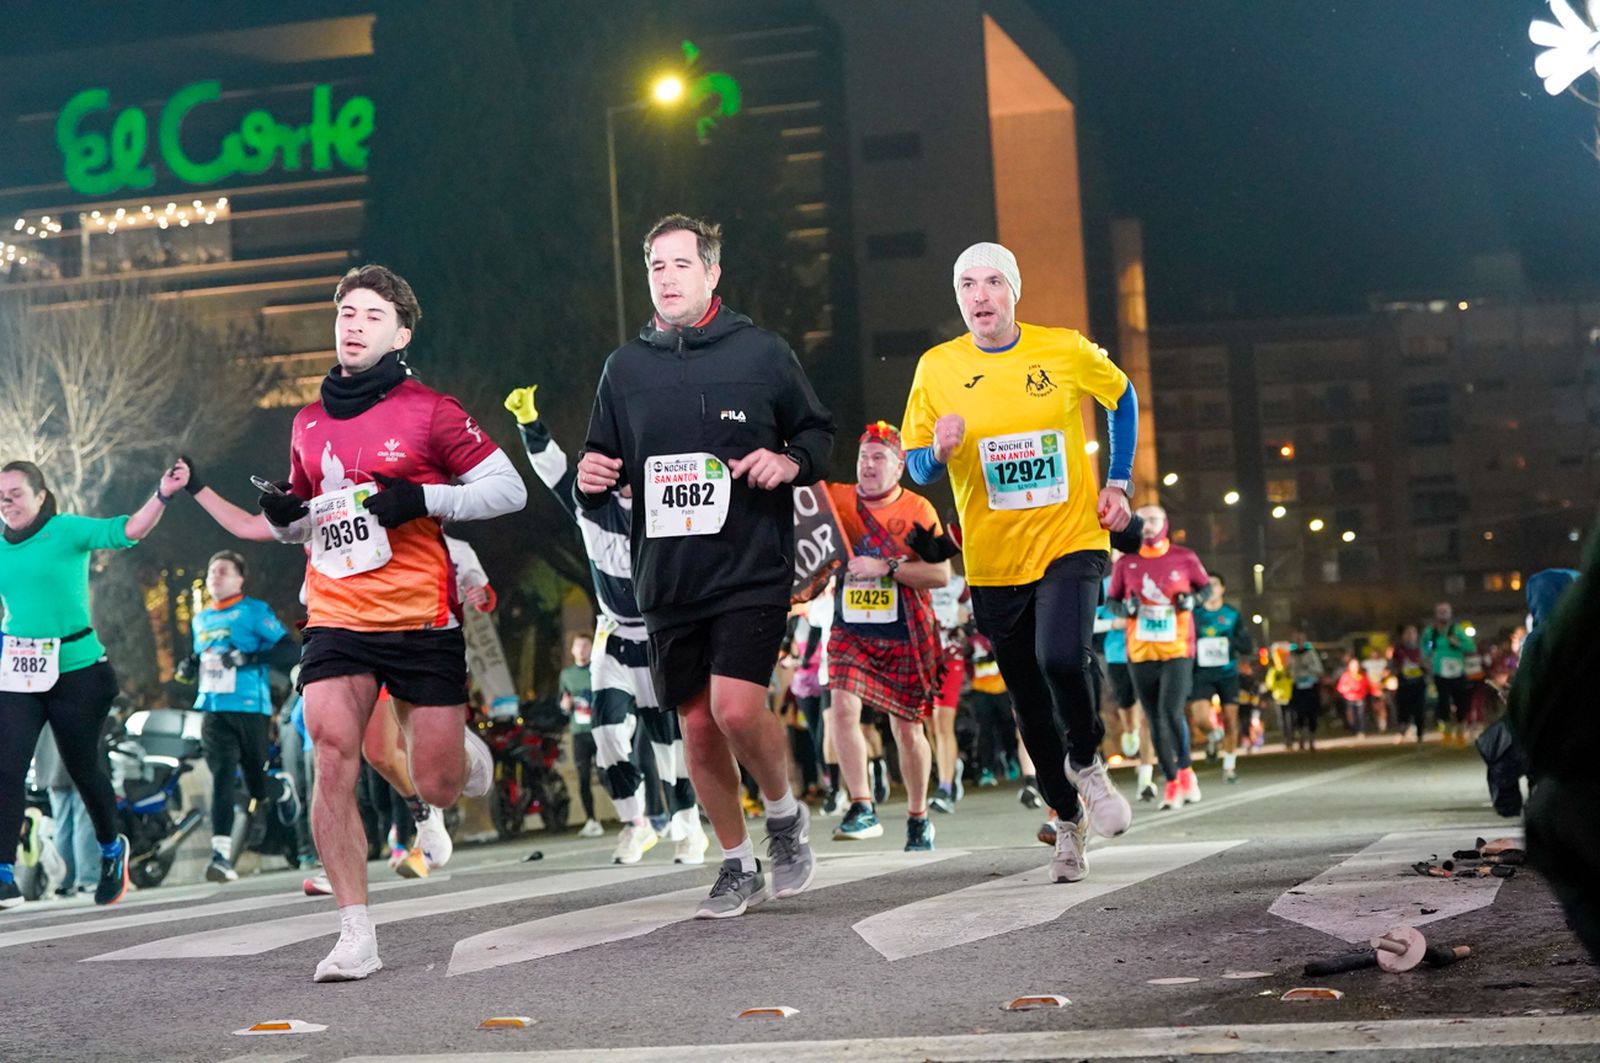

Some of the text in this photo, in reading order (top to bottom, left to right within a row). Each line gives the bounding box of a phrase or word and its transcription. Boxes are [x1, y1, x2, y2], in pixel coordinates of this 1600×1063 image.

[56, 79, 376, 195] El Corte
[720, 410, 747, 420] FILA
[998, 441, 1023, 452] NOCHE
[1024, 441, 1034, 449] DE
[989, 453, 1007, 462] SAN
[664, 464, 688, 473] NOCHE
[689, 463, 698, 471] DE
[994, 456, 1056, 485] 12921
[654, 475, 672, 485] SAN
[661, 482, 715, 508] 4682
[320, 515, 370, 552] 2936
[850, 590, 890, 606] 12425
[12, 656, 48, 673] 2882
